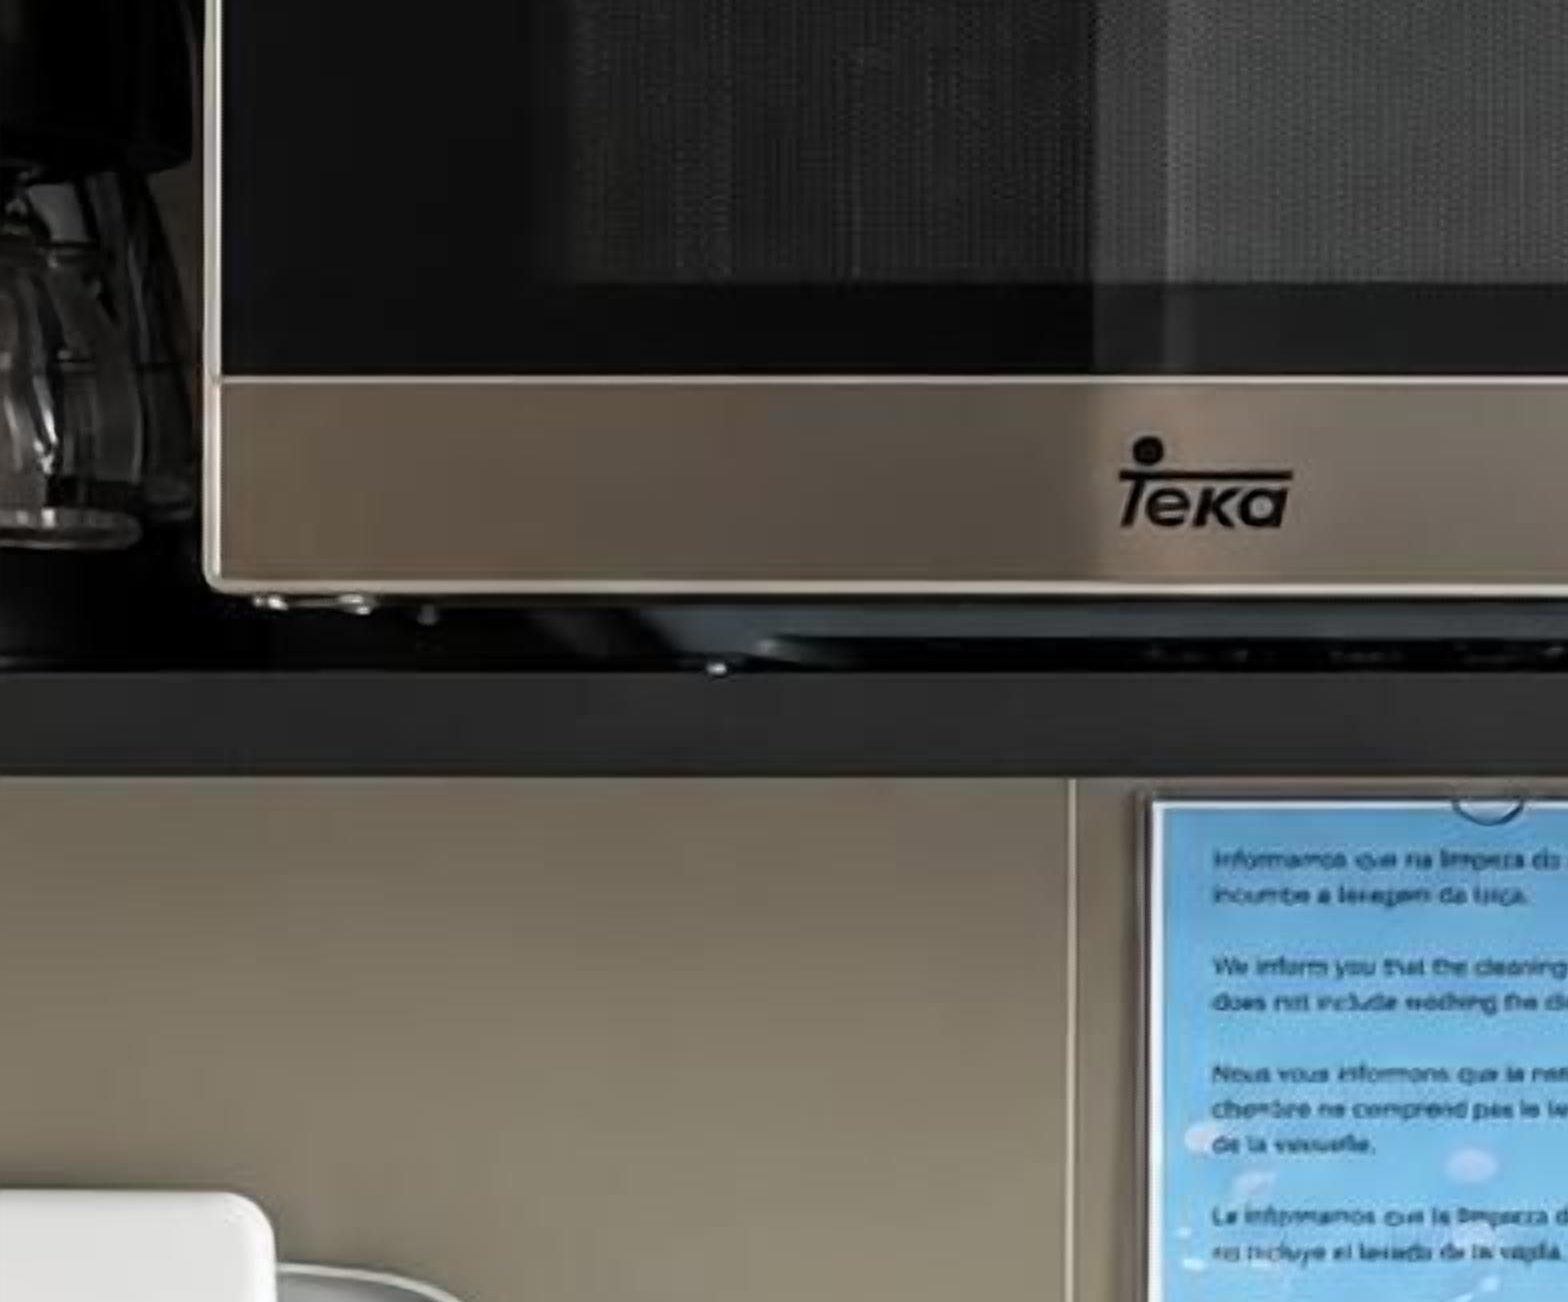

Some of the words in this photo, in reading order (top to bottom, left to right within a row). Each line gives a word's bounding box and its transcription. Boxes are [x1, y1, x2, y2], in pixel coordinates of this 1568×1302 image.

[1215, 849, 1346, 869] Informamos
[1213, 956, 1248, 975] We
[1256, 956, 1328, 975] inform
[1336, 960, 1375, 980] you
[1384, 956, 1424, 975] that
[1432, 956, 1468, 975] the
[1475, 955, 1568, 980] cleaning
[1213, 993, 1266, 1011] does
[1274, 993, 1309, 1011] not
[1317, 993, 1397, 1011] include
[1405, 993, 1497, 1016] washing
[1504, 993, 1538, 1011] the
[1213, 1065, 1270, 1083] Nous
[1278, 1068, 1329, 1083] vous
[1457, 1067, 1499, 1087] que
[1473, 1103, 1513, 1122] pas
